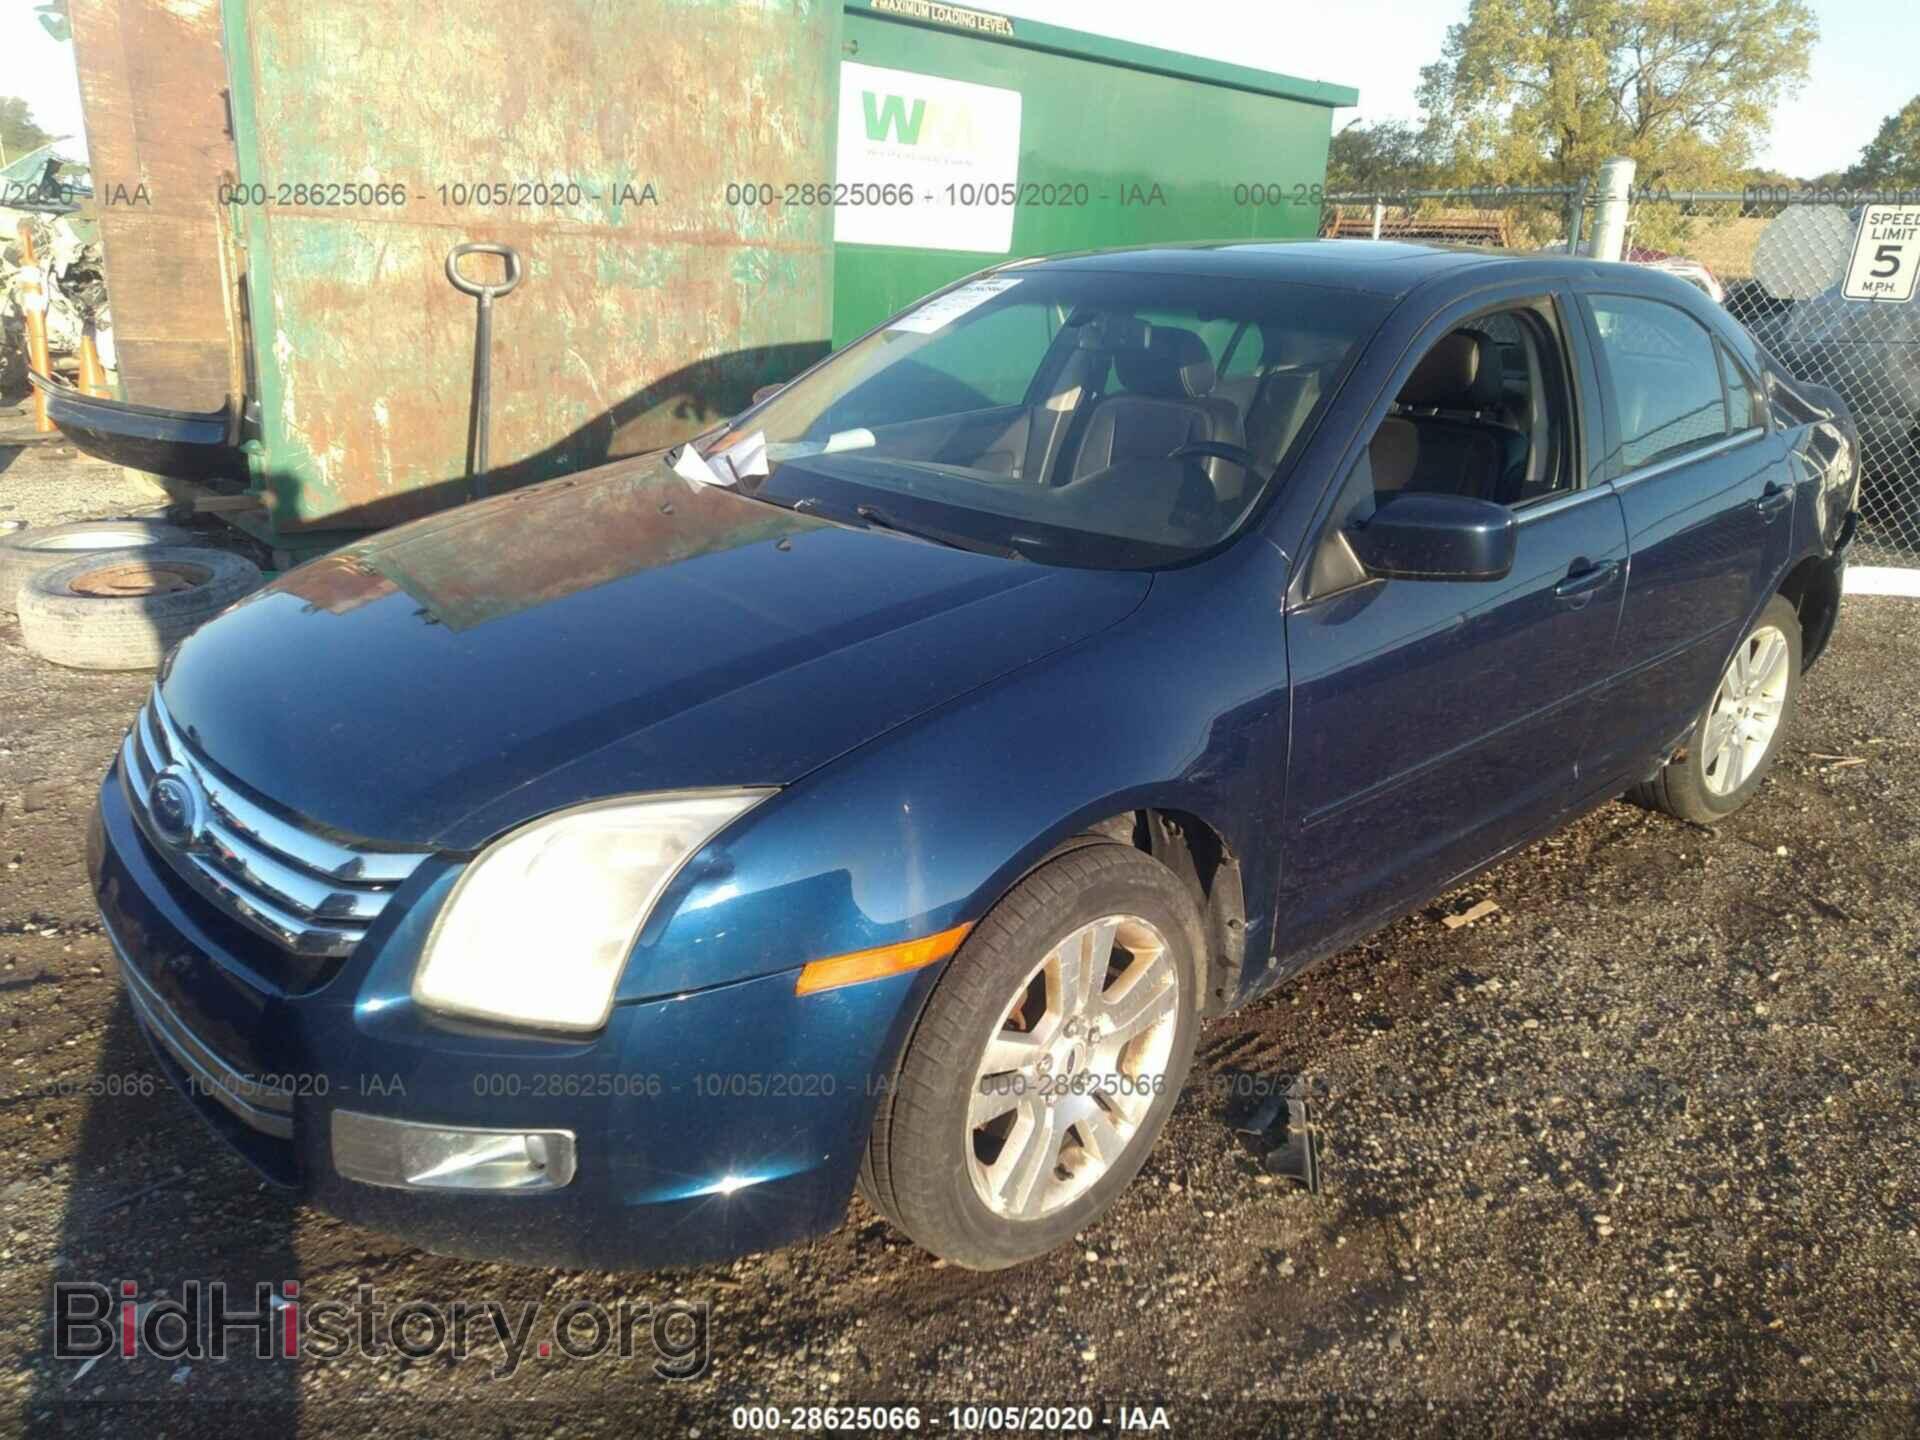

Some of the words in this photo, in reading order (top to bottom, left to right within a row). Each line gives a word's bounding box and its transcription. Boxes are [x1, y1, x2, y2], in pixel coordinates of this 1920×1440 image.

[931, 7, 976, 28] LOADING
[1871, 228, 1918, 240] LIMIT
[1869, 245, 1903, 278] 5
[1862, 281, 1896, 292] M.P.H.
